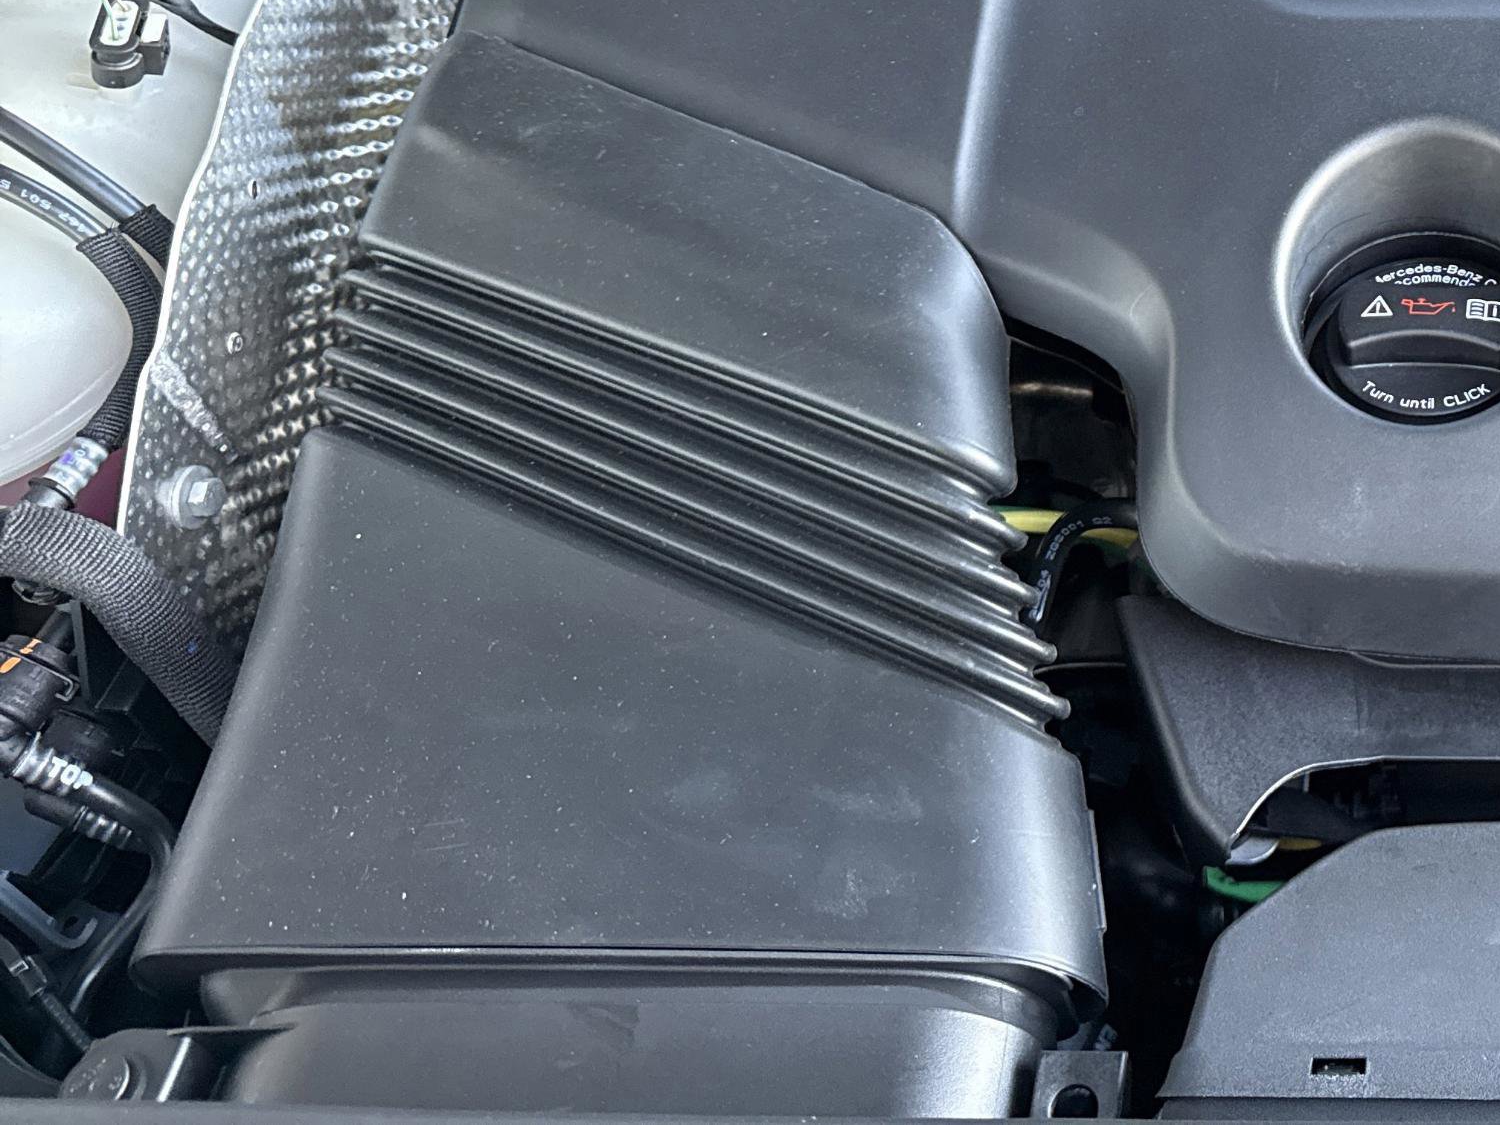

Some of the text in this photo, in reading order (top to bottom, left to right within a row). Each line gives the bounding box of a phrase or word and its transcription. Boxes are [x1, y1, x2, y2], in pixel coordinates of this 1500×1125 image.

[1362, 380, 1491, 409] Turn until CLICK
[48, 755, 94, 790] TOP
